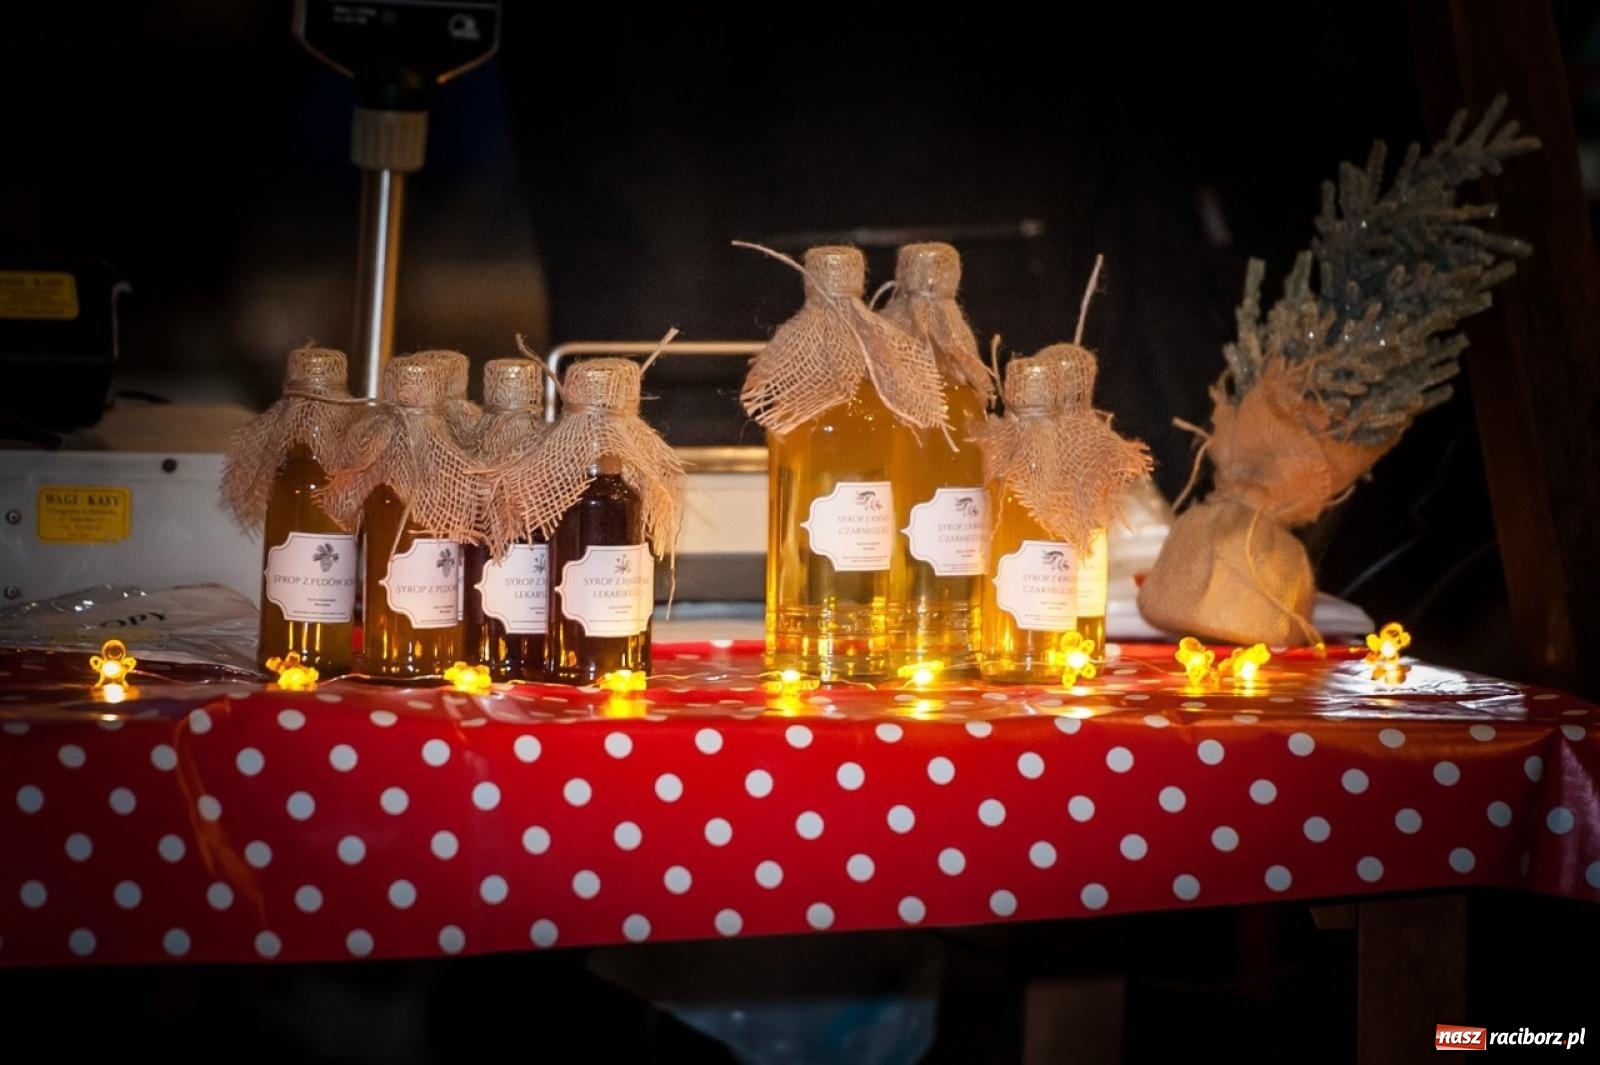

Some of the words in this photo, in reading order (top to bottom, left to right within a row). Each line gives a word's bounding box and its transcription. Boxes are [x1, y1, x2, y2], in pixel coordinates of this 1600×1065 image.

[45, 494, 78, 505] WAGI
[87, 495, 119, 506] KASY
[837, 515, 865, 523] SYROP
[937, 523, 964, 531] SYROP
[273, 575, 301, 585] SYROP
[302, 576, 309, 586] Z
[504, 577, 535, 586] SYROP
[536, 577, 541, 586] Z
[583, 576, 614, 585] SYROP
[615, 576, 621, 585] Z
[395, 584, 427, 594] SYROP
[428, 584, 434, 593] Z
